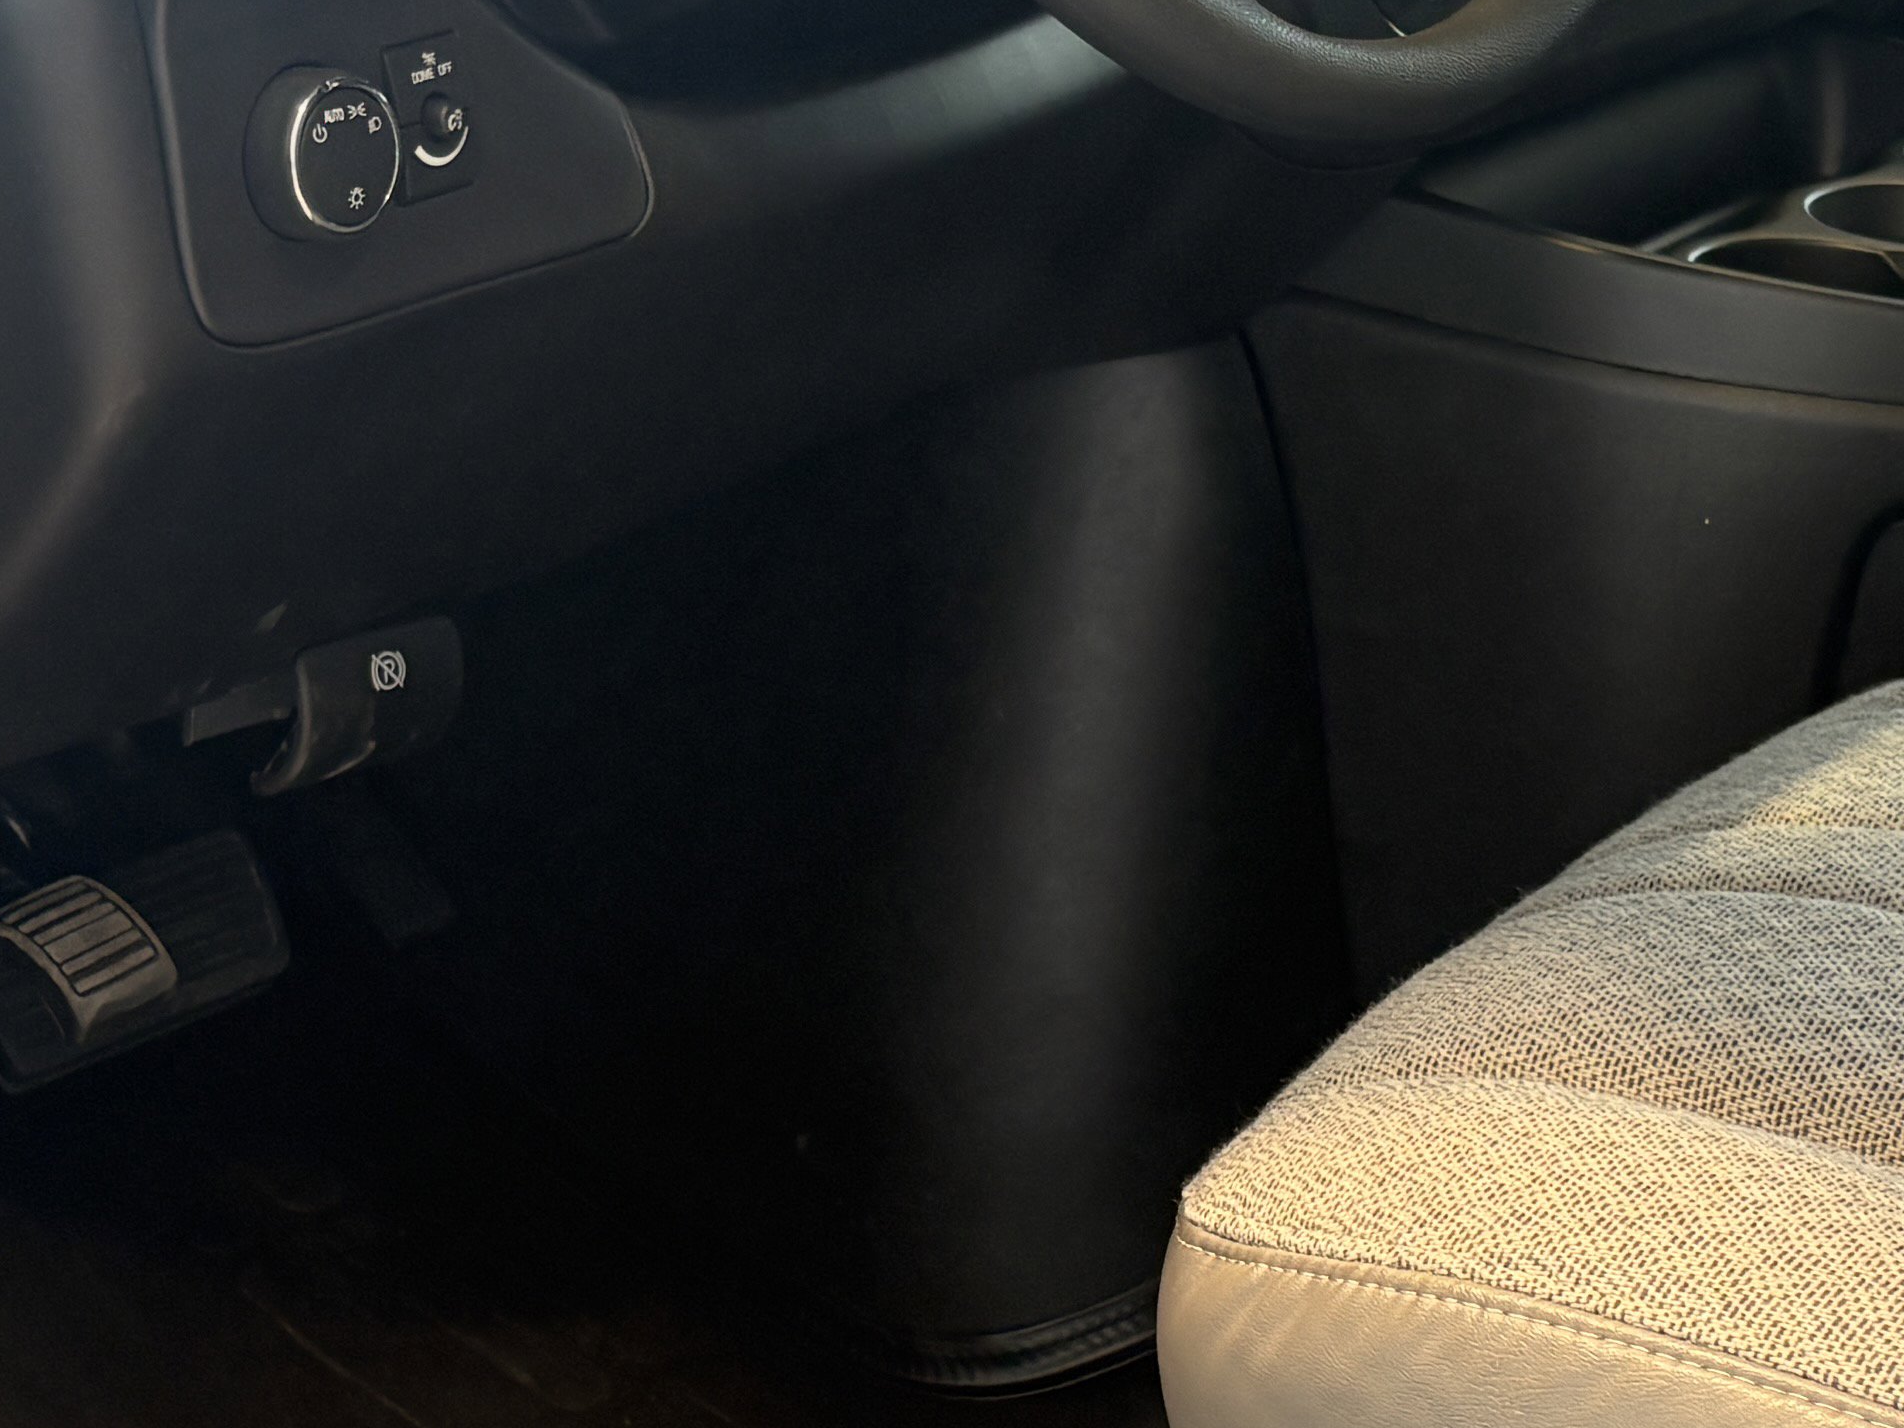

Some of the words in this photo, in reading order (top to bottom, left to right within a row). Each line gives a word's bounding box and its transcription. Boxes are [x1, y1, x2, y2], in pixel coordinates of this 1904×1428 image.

[411, 67, 435, 85] DOME
[437, 61, 452, 76] OFF
[324, 107, 345, 123] AUTO
